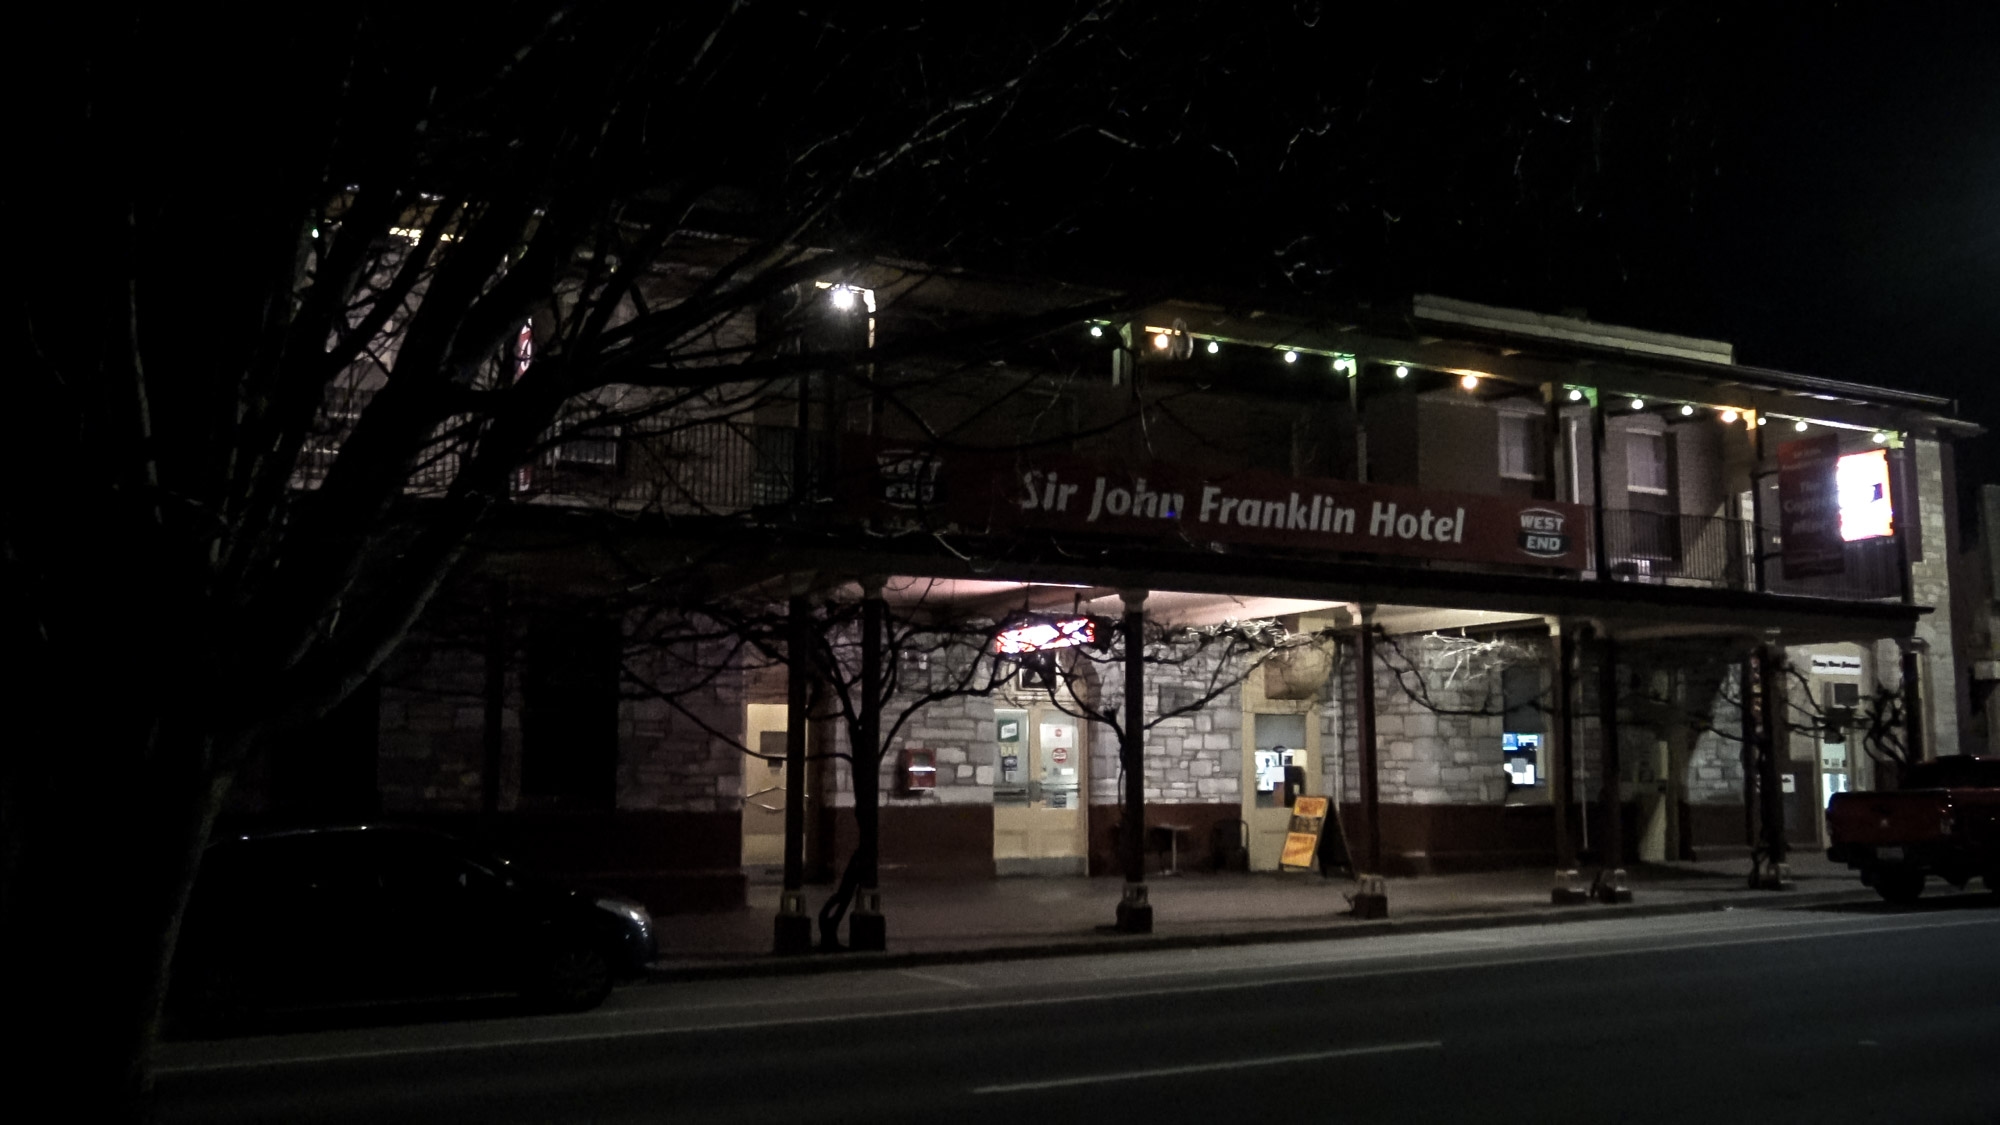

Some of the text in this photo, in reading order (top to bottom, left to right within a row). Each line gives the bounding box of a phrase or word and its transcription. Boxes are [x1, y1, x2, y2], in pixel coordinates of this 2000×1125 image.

[1021, 470, 1465, 544] Sir John Franklin Hotel
[1520, 514, 1565, 532] WEST
[1526, 535, 1561, 551] END
